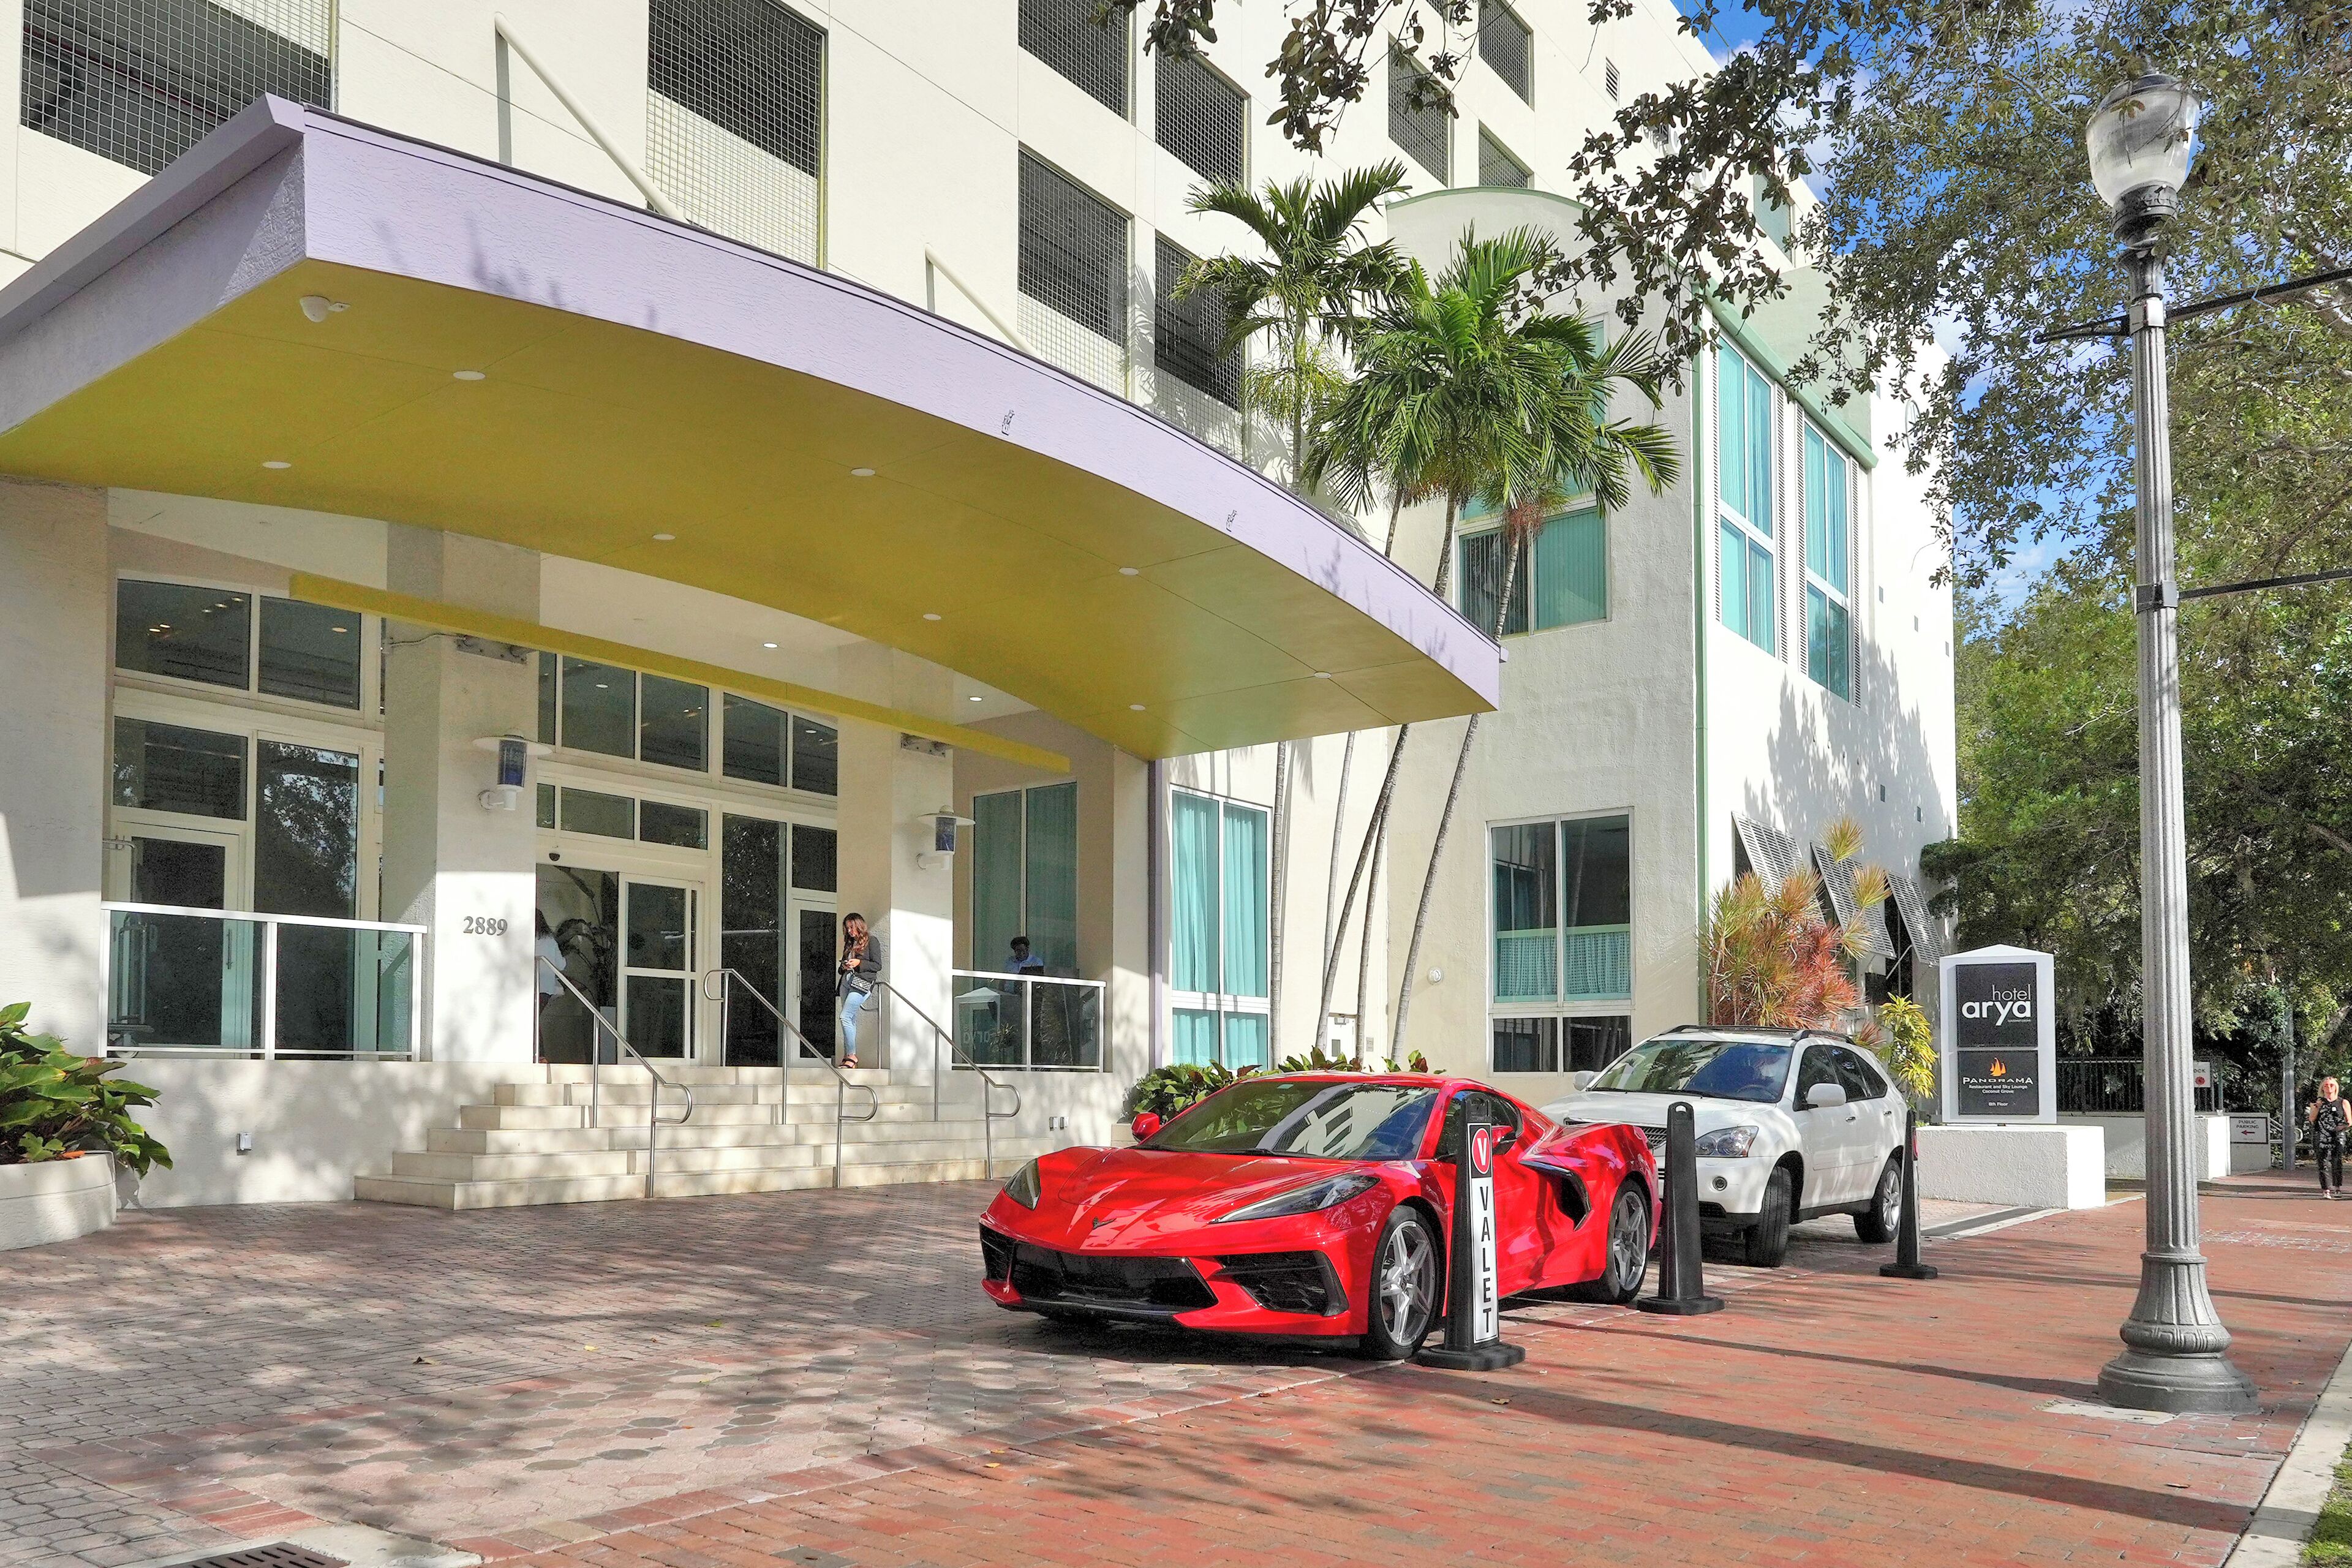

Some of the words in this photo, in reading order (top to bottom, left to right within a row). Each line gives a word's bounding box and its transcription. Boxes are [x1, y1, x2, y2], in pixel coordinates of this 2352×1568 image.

[463, 916, 508, 936] 2889
[1992, 984, 2031, 1000] hotel
[1961, 1001, 2031, 1026] arya
[1477, 1137, 1487, 1166] V
[1479, 1186, 1491, 1333] VALET
